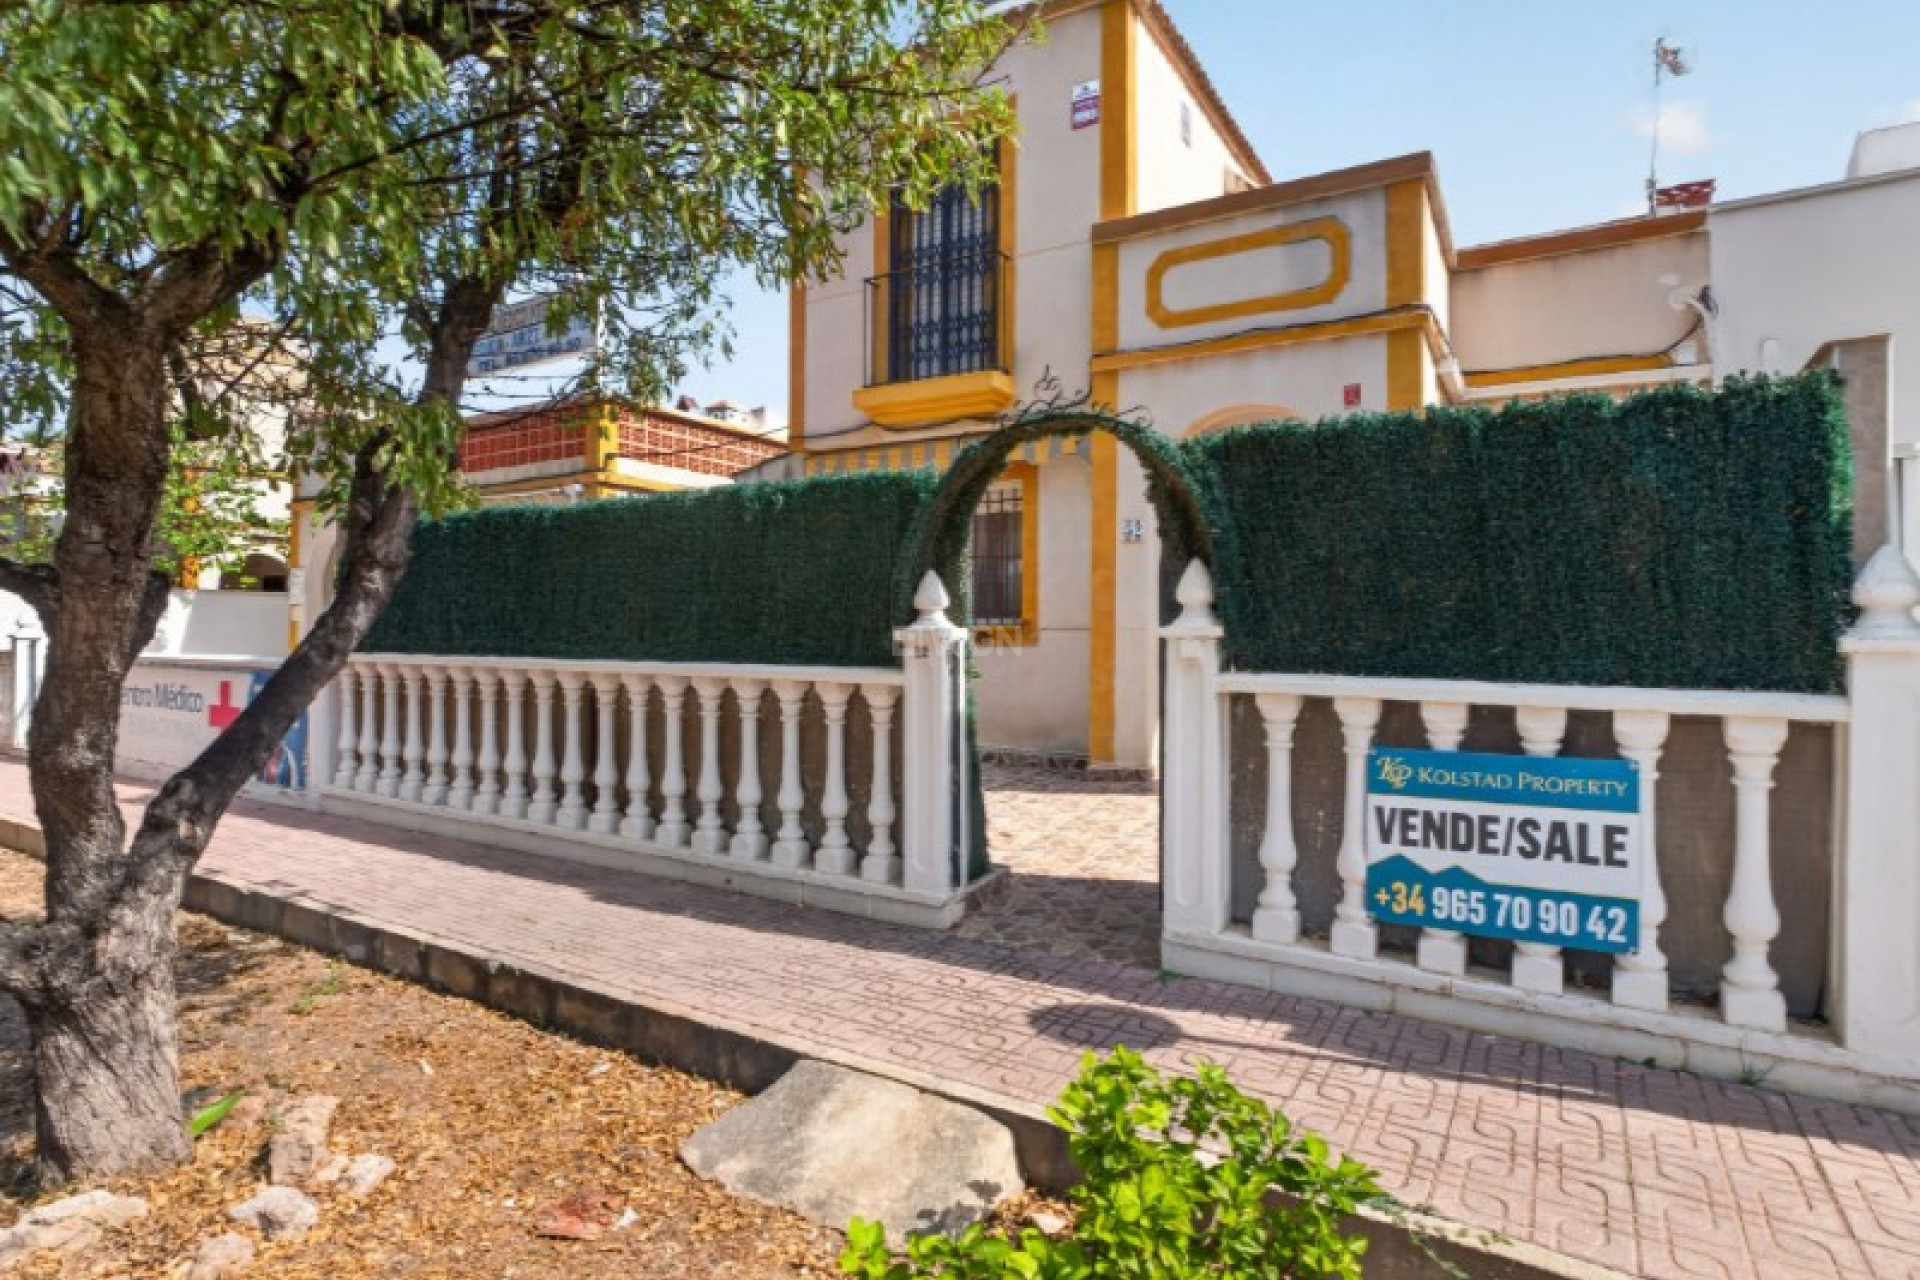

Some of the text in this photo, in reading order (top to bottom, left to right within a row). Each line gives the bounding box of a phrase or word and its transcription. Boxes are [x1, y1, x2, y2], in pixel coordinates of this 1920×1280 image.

[121, 686, 152, 708] entro
[1418, 766, 1628, 798] KOLSTAD PROPERTY
[1374, 805, 1629, 869] VENDE/SALE
[1375, 881, 1628, 944] +34 965 70 90 42
